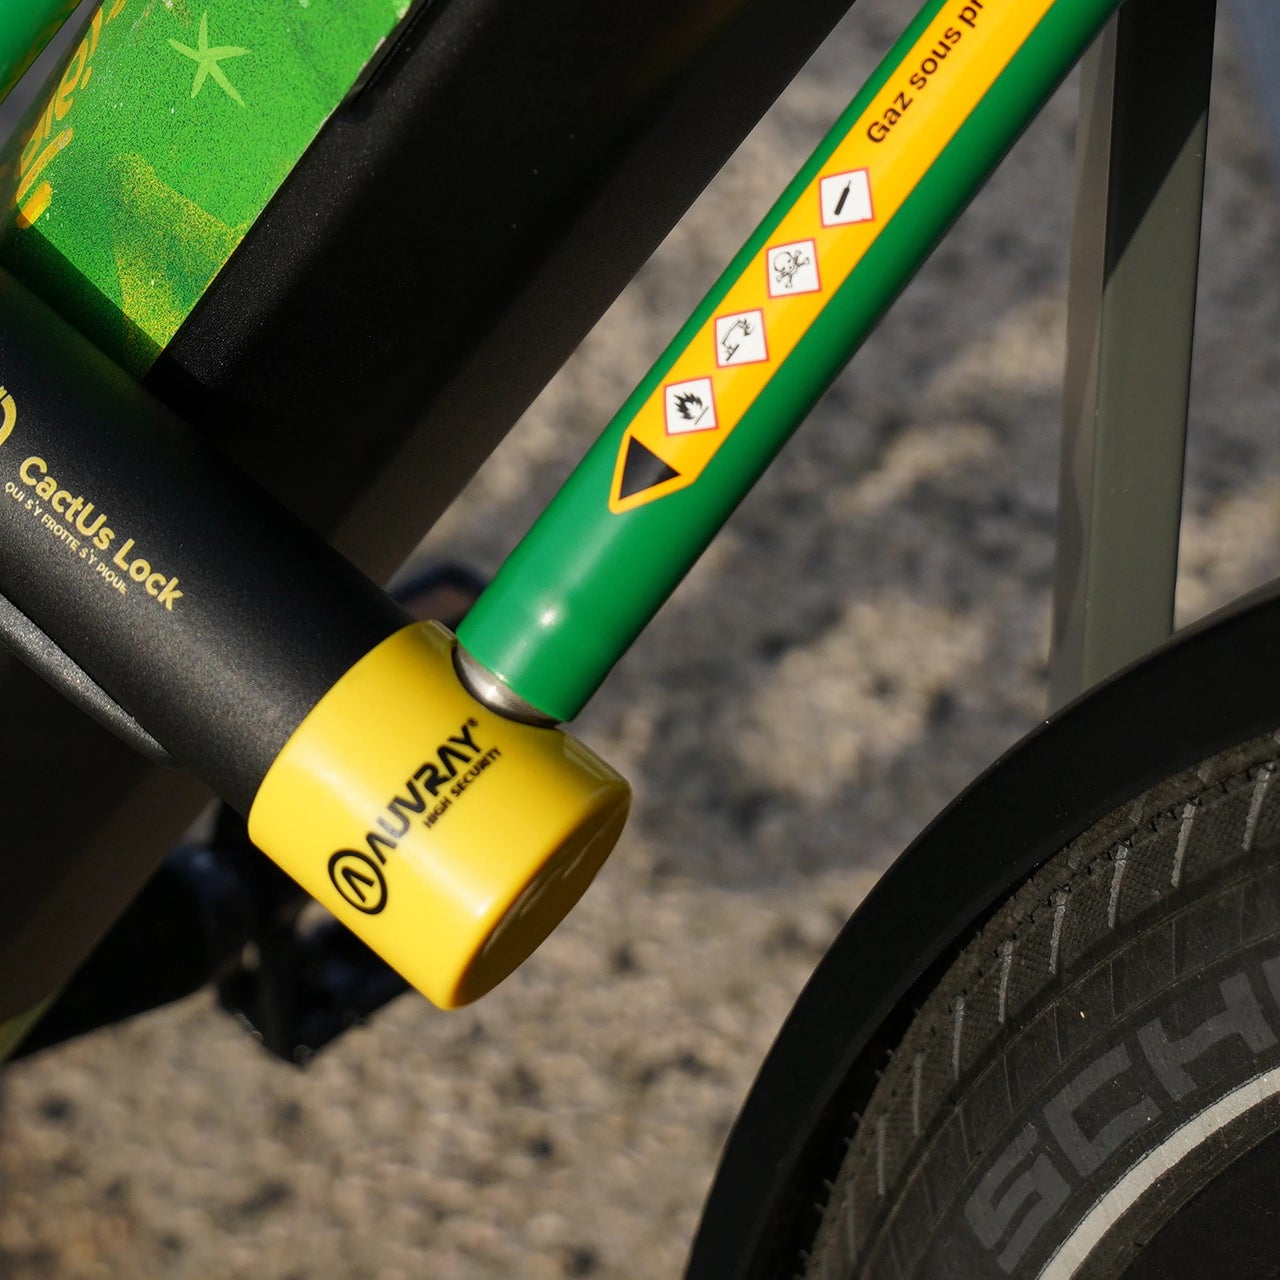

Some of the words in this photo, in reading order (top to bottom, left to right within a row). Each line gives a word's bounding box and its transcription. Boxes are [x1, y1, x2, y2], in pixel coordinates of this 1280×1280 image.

[866, 92, 913, 144] Gaz
[908, 28, 962, 91] sous
[4, 481, 25, 502] QUI
[24, 498, 43, 517] S'Y
[40, 513, 81, 552] FROTTE
[78, 547, 98, 566] S'Y
[95, 562, 128, 595] PIQUE
[113, 538, 184, 611] Lock
[423, 796, 453, 829] HIGH
[450, 746, 503, 798] SECURITY
